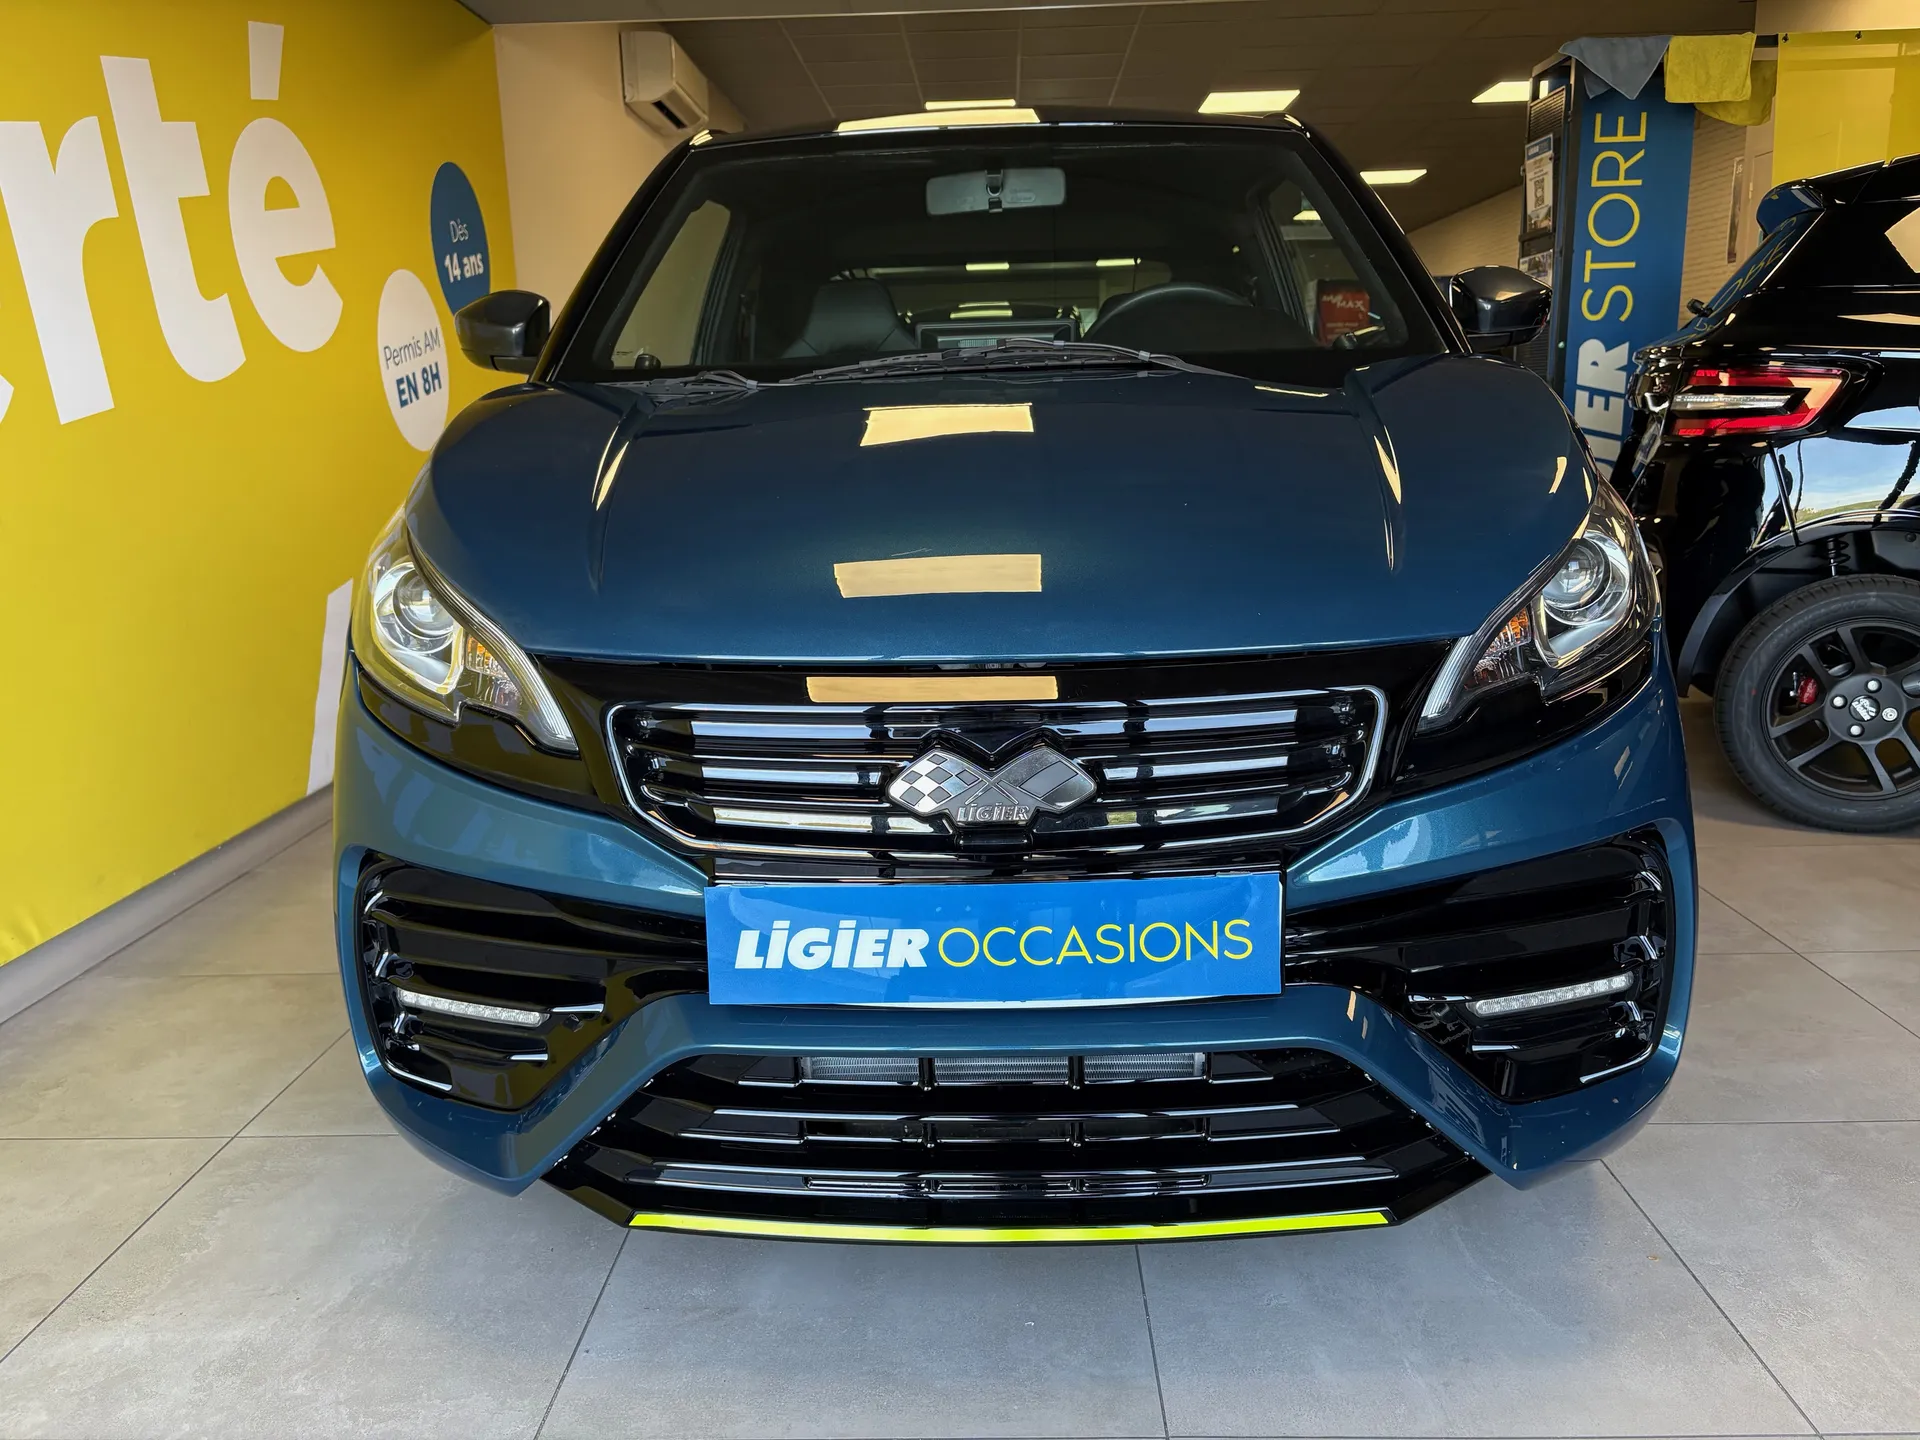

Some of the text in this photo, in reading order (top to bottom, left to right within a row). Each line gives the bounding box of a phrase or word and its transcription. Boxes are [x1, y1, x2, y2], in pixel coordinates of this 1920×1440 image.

[0, 21, 343, 425] rté
[450, 218, 469, 243] Dès
[444, 252, 484, 283] 14 ans
[1574, 112, 1647, 482] IER STORE
[383, 326, 441, 370] Permis AM
[395, 361, 442, 408] EN 8H
[734, 919, 1253, 970] LIGIER OCCASIONS
